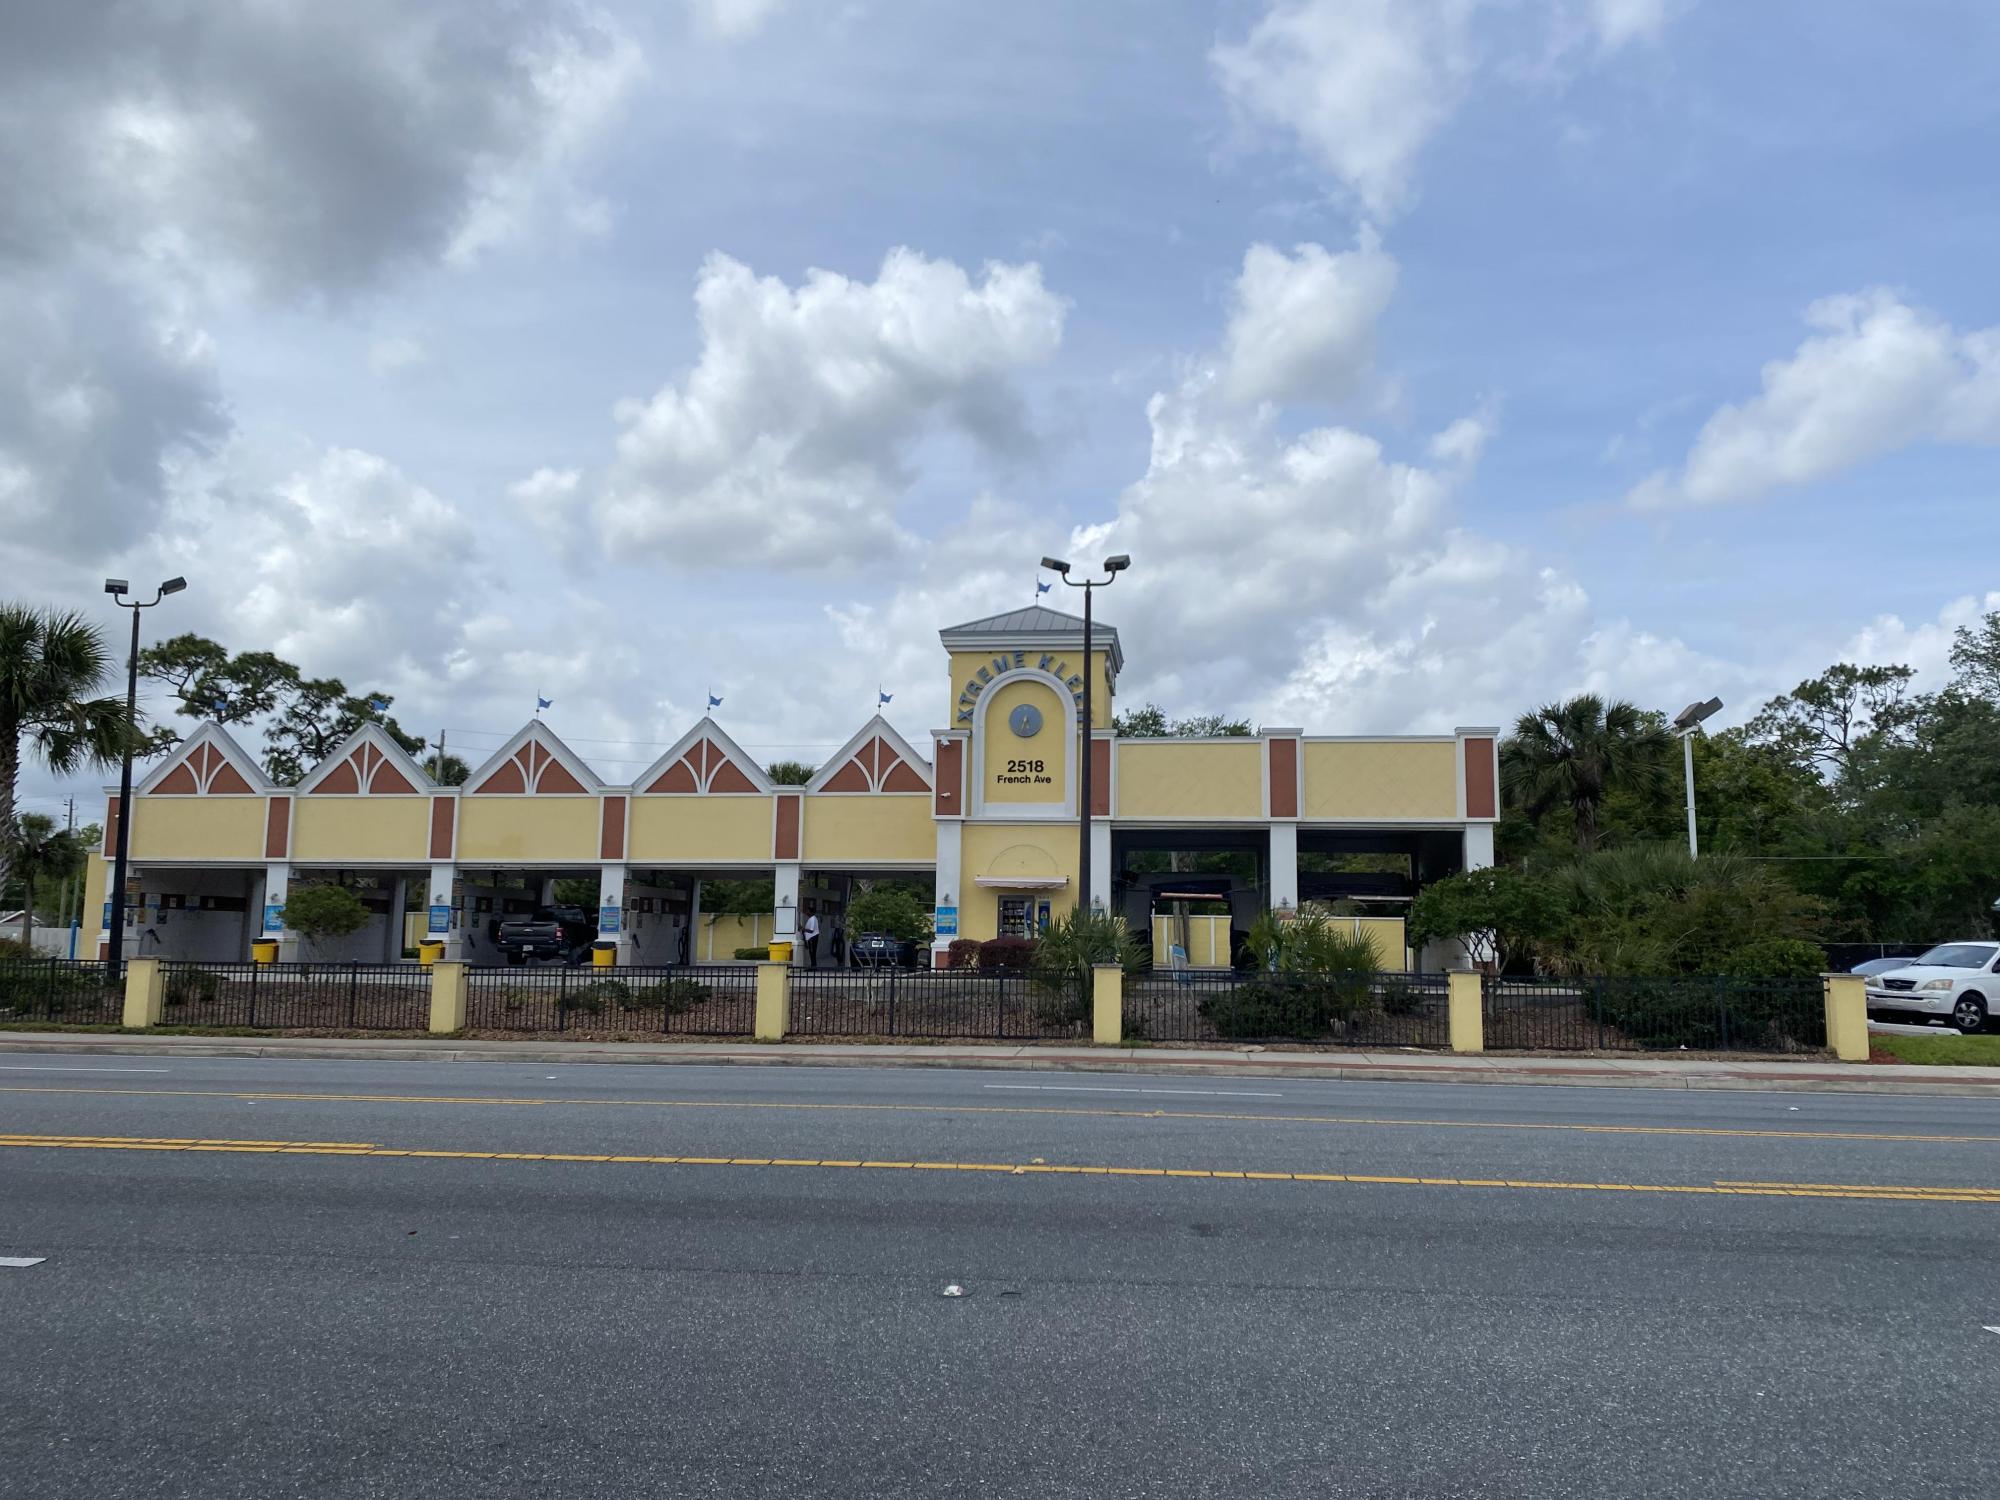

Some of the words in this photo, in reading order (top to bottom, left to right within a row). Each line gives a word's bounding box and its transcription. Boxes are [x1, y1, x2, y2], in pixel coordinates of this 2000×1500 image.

[957, 650, 1025, 722] XTREME
[1007, 759, 1044, 773] 2518
[997, 774, 1031, 784] French
[1034, 774, 1052, 784] Ave
